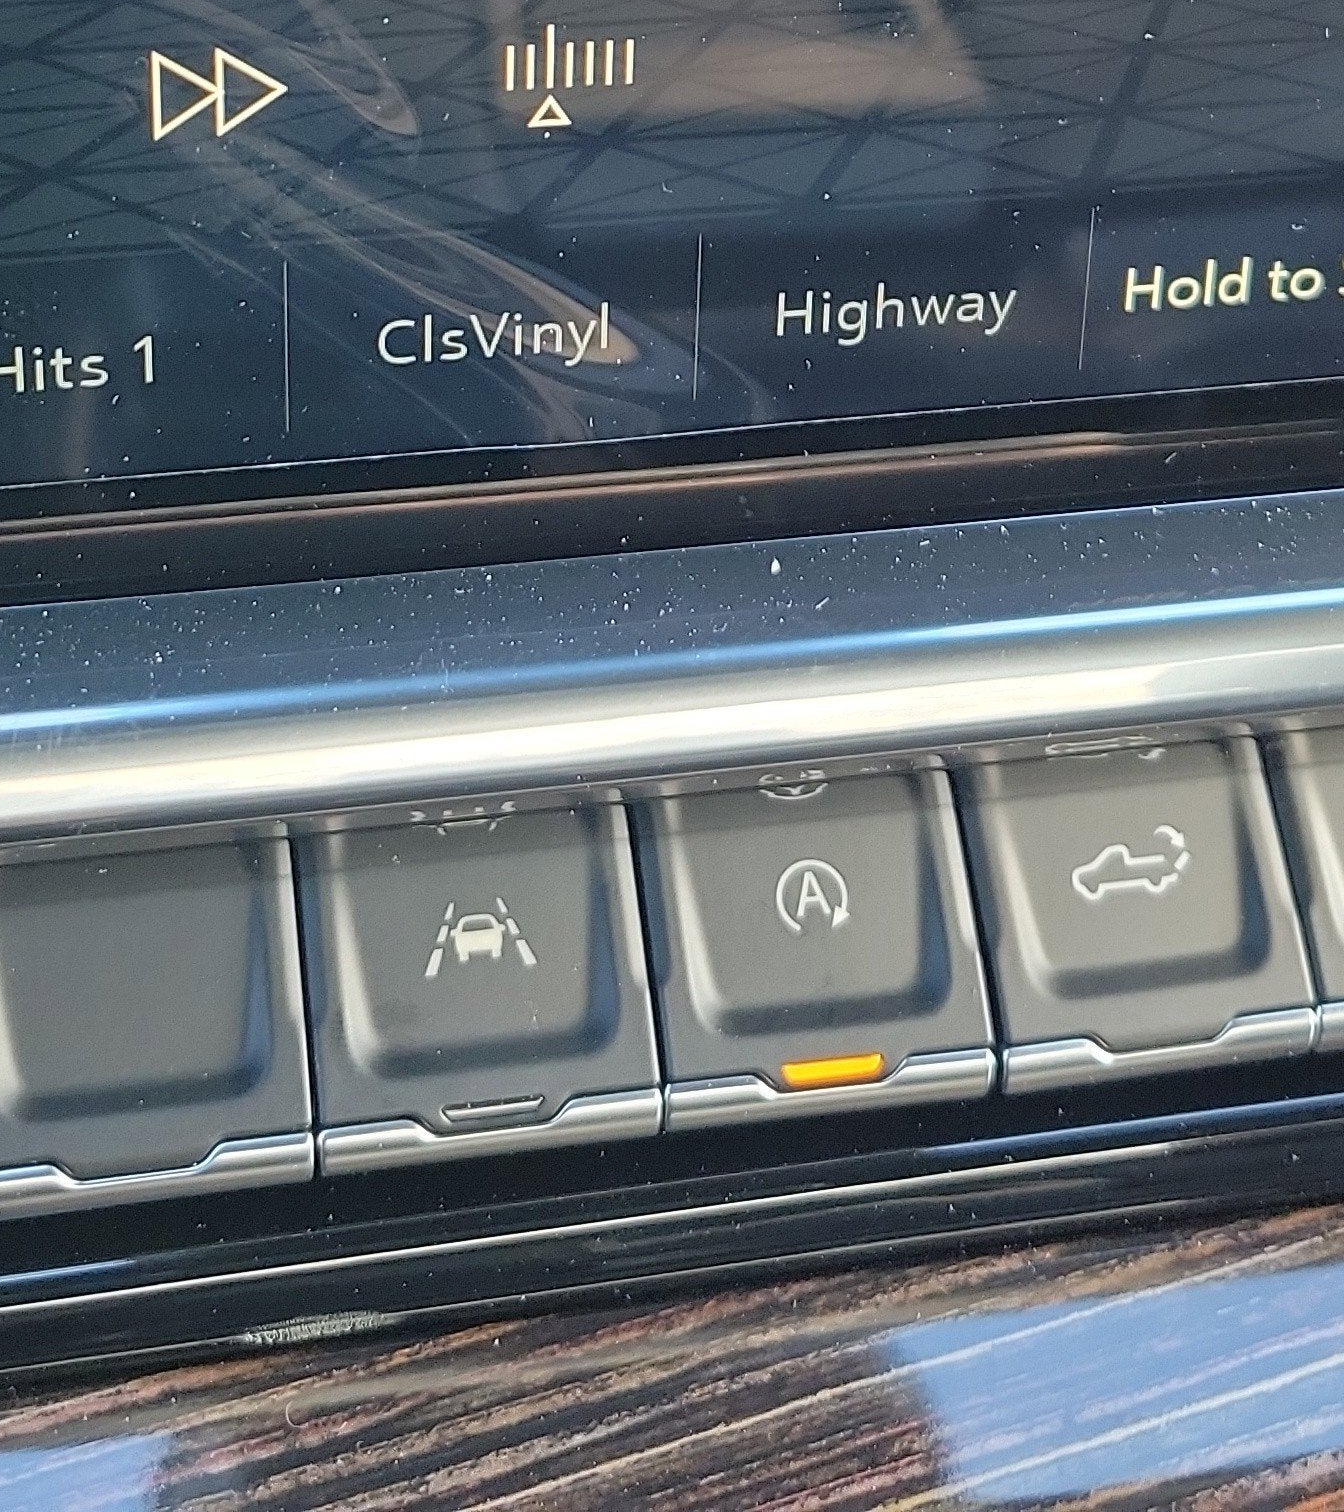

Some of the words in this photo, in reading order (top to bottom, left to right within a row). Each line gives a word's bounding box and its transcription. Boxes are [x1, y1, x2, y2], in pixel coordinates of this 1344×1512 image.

[775, 281, 1019, 347] Highway
[1123, 255, 1254, 314] Hold
[1267, 259, 1327, 303] to
[132, 334, 155, 385] 1
[376, 300, 610, 368] ClsVinyl
